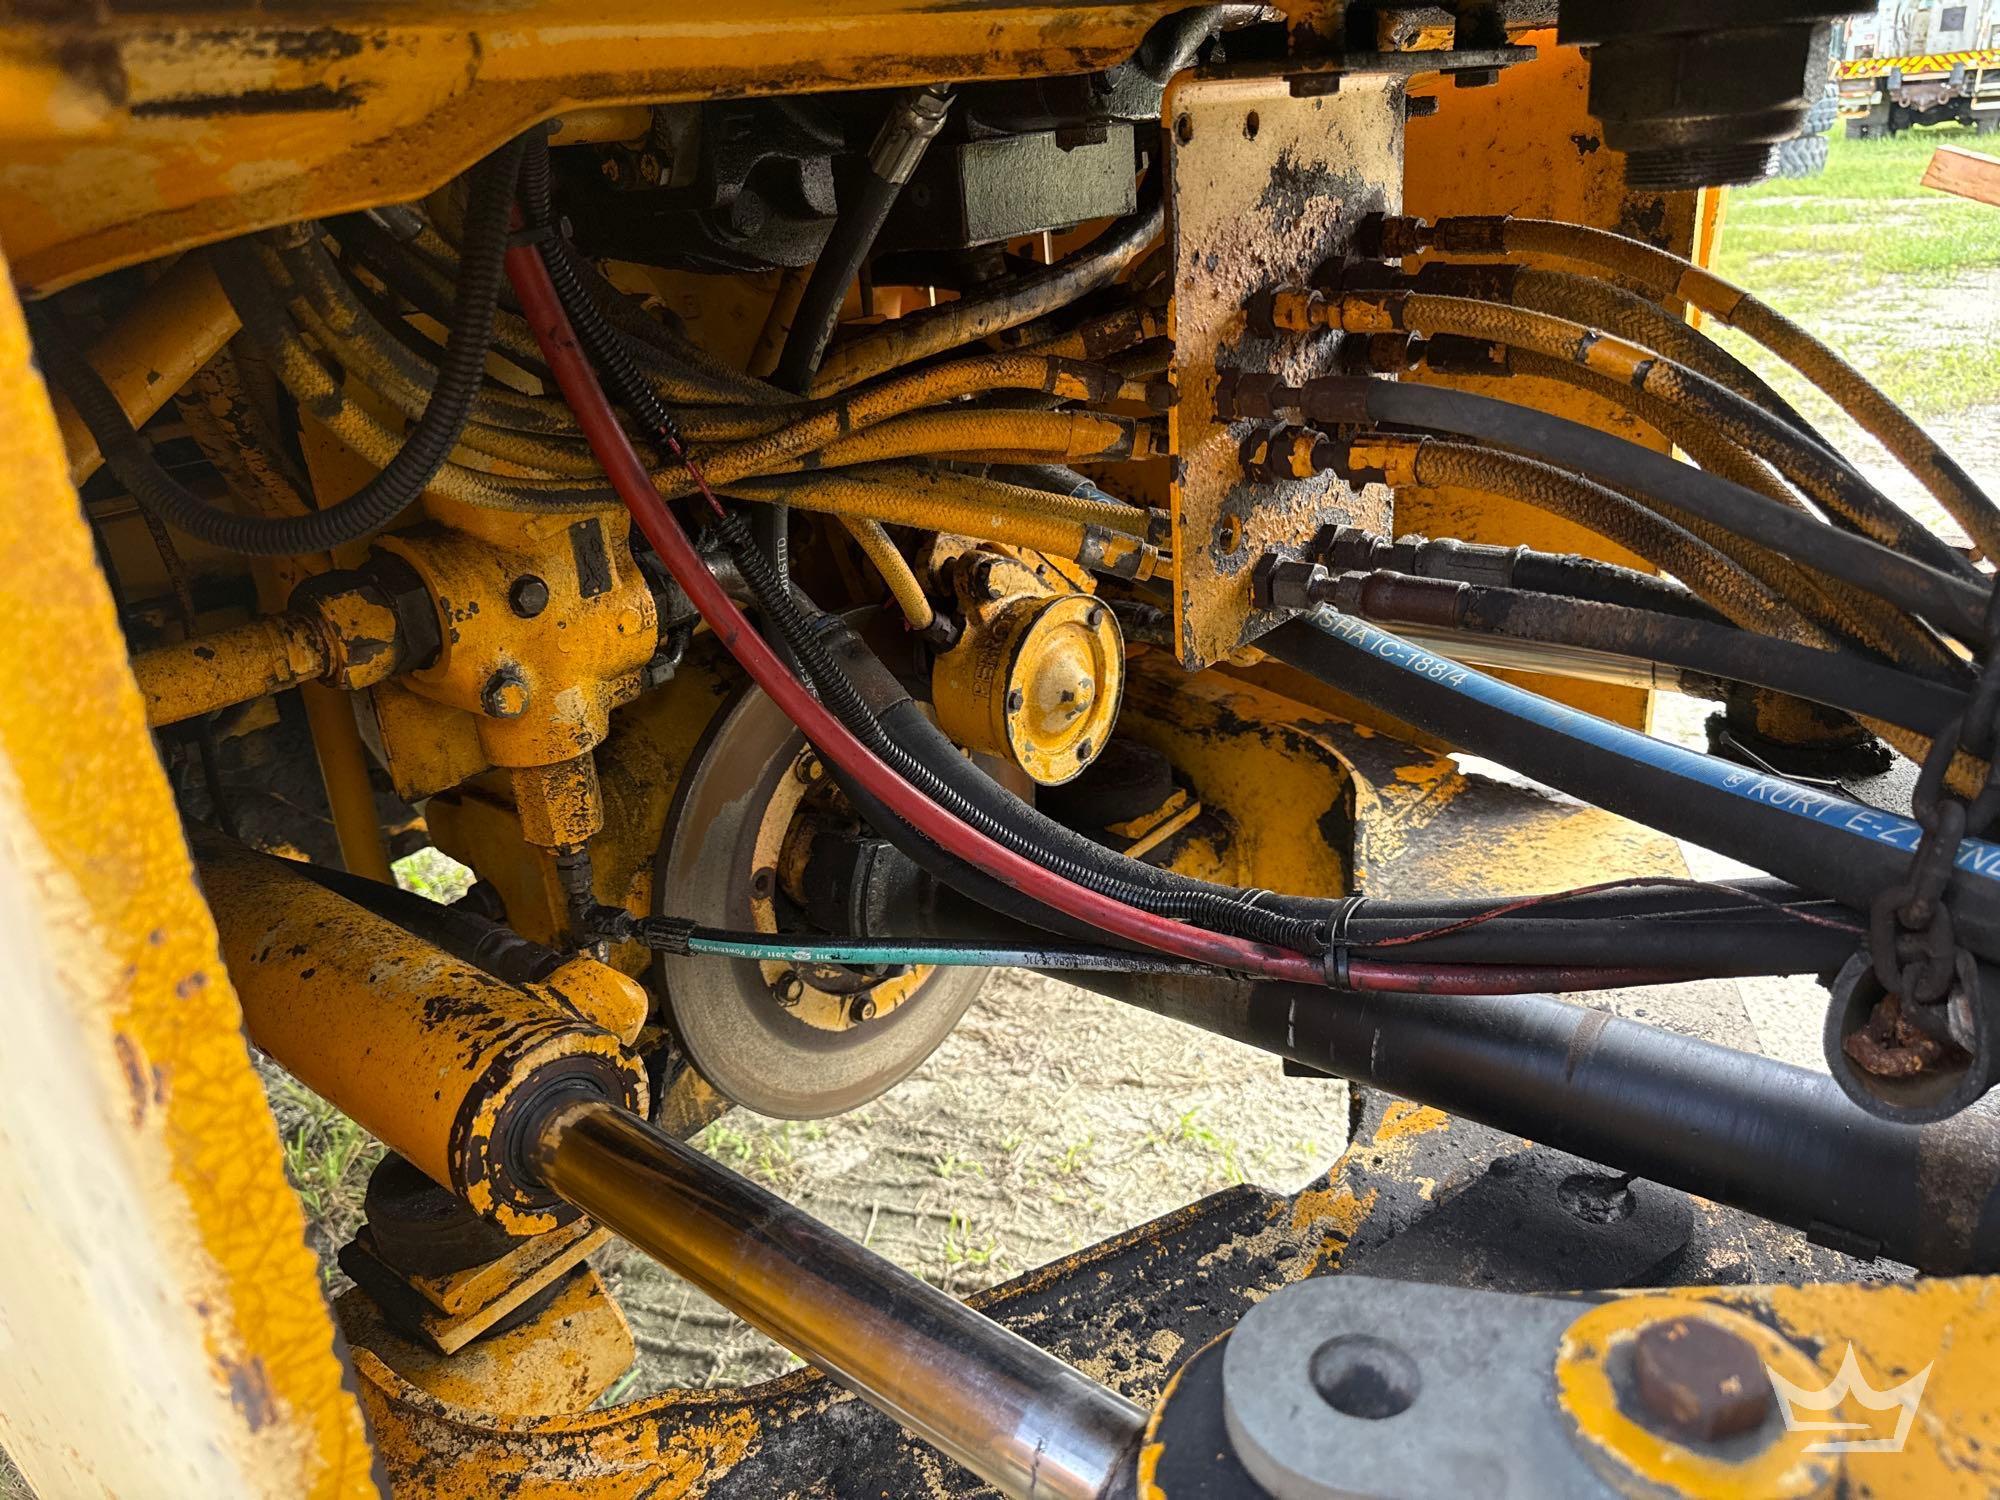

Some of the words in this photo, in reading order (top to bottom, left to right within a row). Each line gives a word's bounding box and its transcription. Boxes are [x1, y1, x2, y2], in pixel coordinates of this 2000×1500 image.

[1370, 638, 1468, 687] IC-188/4
[1748, 781, 1835, 817] KURT
[1845, 811, 1916, 843] E-Z
